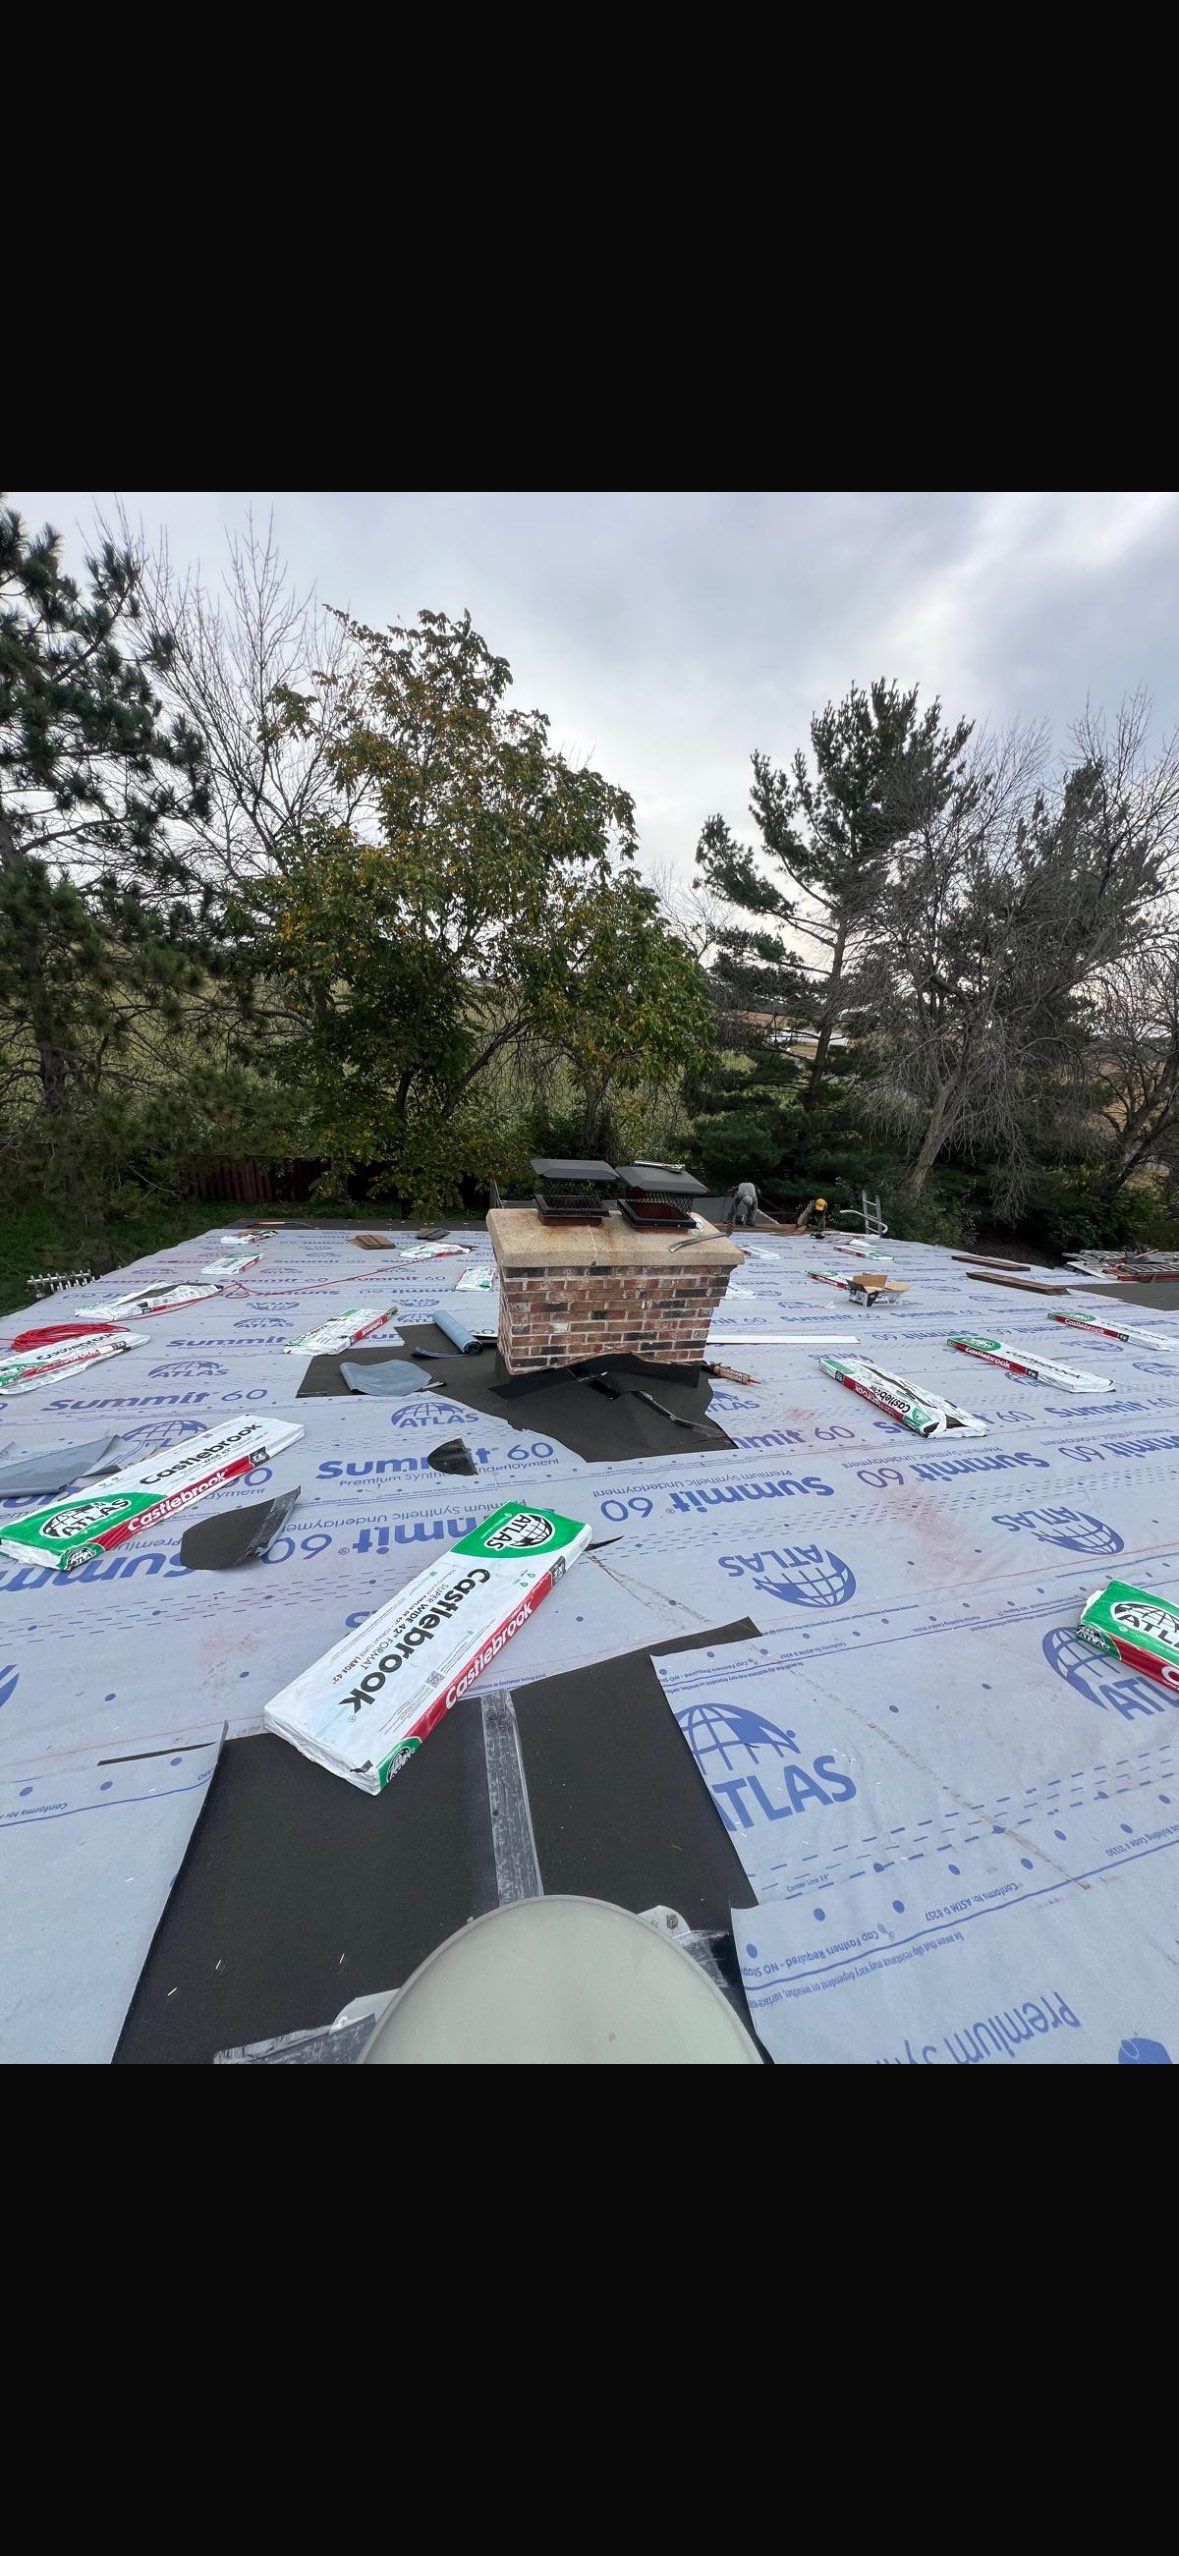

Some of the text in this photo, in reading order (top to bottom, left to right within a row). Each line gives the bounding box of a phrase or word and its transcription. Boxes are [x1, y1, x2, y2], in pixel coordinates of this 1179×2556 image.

[165, 1335, 287, 1348] Summit
[151, 1368, 230, 1379] ATLAS
[41, 1391, 211, 1412] Summit
[221, 1388, 267, 1402] 60
[1043, 1397, 1149, 1420] Summit
[400, 1411, 480, 1429] ATLAS
[996, 1410, 1037, 1424] 60
[814, 1424, 856, 1441] 60
[139, 1421, 264, 1485] Castlebrook
[507, 1442, 554, 1461] 60
[1057, 1444, 1107, 1463] 60
[339, 1473, 401, 1487] Premium
[478, 1458, 559, 1475] nderlayment
[856, 1451, 1051, 1489] Summit 60
[593, 1469, 792, 1498] Premium Synthetic Underlayment
[127, 1467, 229, 1534] Castlebrook
[599, 1476, 835, 1523] Summit 60
[63, 1498, 131, 1537] ATLAS
[280, 1510, 388, 1537] Underlayme
[392, 1503, 460, 1524] Synthetic
[991, 1506, 1081, 1532] ATLAS
[485, 1513, 533, 1552] ATLAS
[261, 1533, 333, 1568] 60
[718, 1543, 826, 1579] ATLAS
[426, 1582, 449, 1604] SUPER
[406, 1603, 429, 1624] WIDE
[338, 1567, 492, 1715] Castlebrook
[1116, 1613, 1179, 1651] ATL
[341, 1655, 361, 1674] LARGE
[361, 1636, 393, 1671] FORMAT
[445, 1601, 534, 1710] Castlebrook
[1099, 1677, 1179, 1720] ATL
[21, 1802, 68, 1816] Conforms
[982, 1881, 1018, 1903] Conforms
[924, 1907, 943, 1922] 8257
[949, 1897, 971, 1913] ASTM
[861, 1930, 880, 1942] Cap
[763, 1962, 779, 1975] NO
[785, 1948, 825, 1969] Required
[820, 1968, 856, 1991] dependent
[944, 1991, 1082, 2064] Premium
